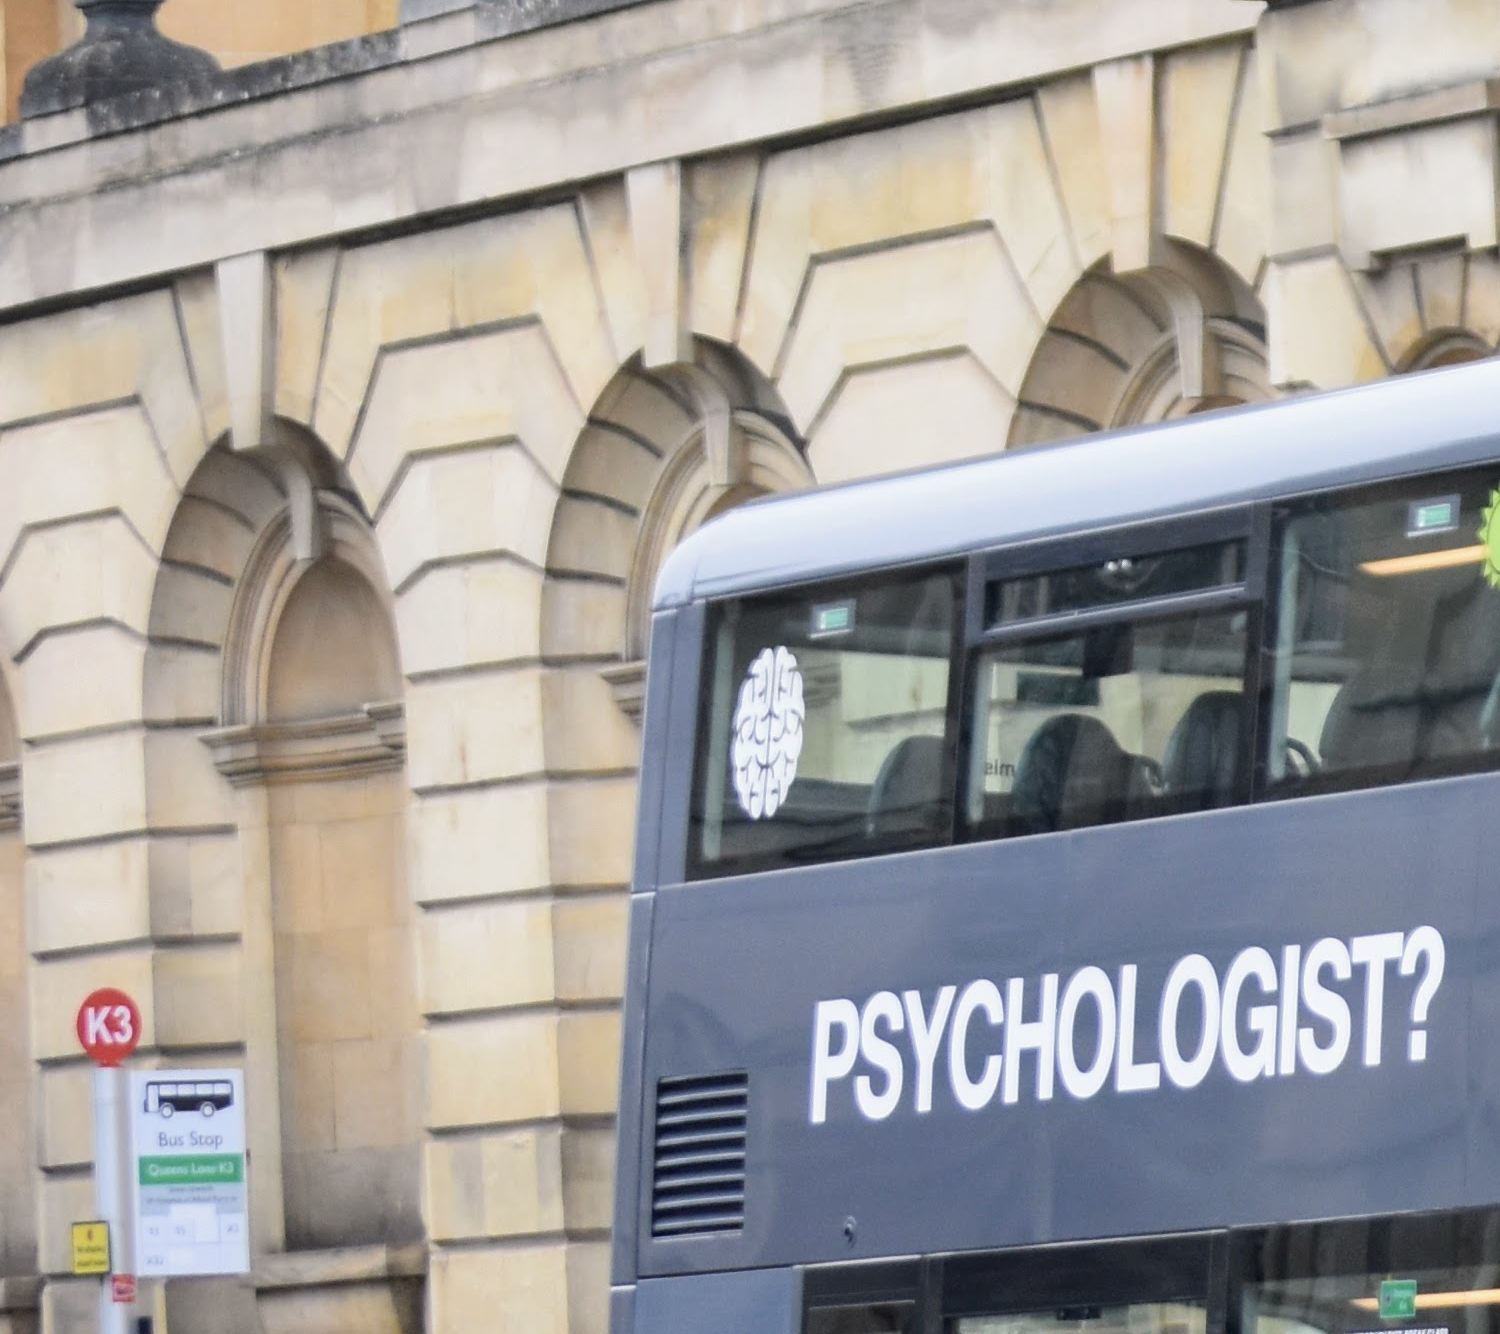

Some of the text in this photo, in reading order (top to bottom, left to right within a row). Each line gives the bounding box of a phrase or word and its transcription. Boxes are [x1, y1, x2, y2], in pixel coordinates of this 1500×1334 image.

[84, 1005, 133, 1045] K3
[809, 924, 1447, 1125] PSYCHOLOGIST?
[158, 1130, 223, 1149] Bus Stop
